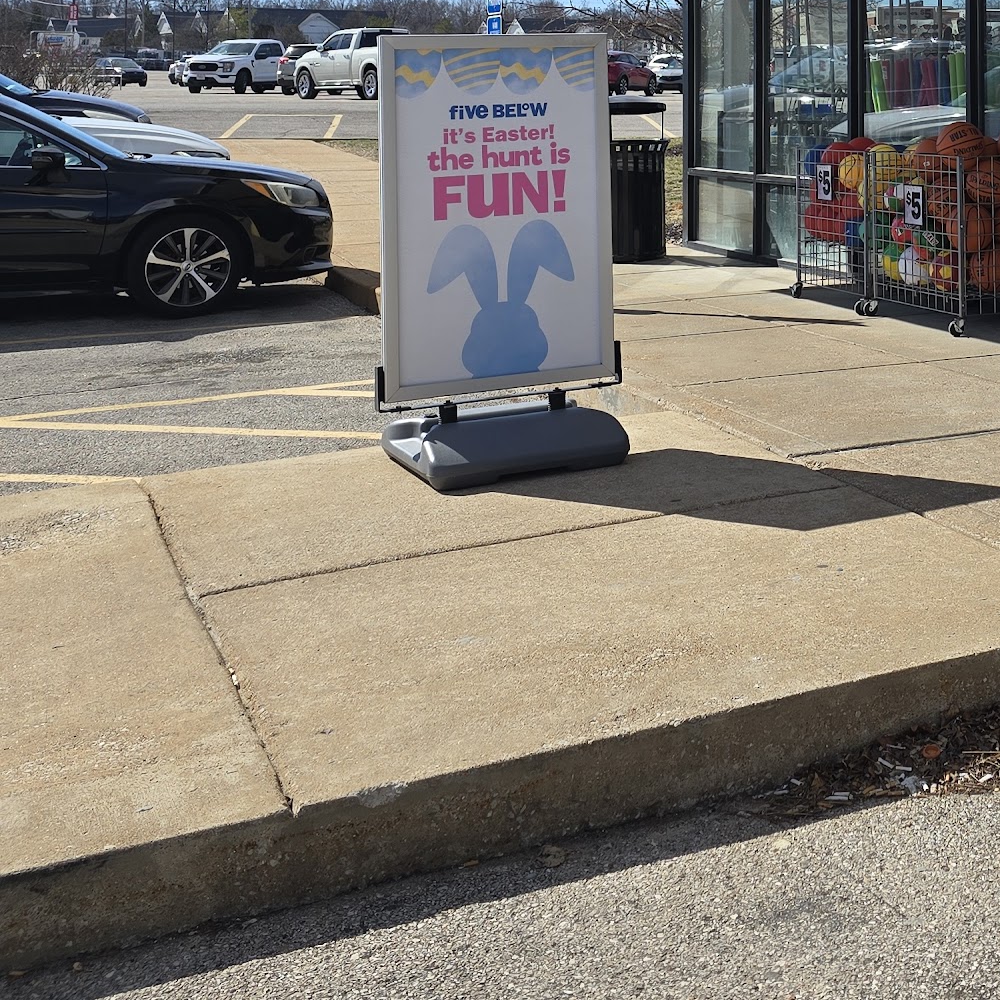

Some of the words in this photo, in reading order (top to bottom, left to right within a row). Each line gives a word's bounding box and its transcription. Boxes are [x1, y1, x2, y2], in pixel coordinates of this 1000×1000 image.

[449, 104, 488, 120] five
[492, 102, 548, 119] BELOW
[482, 124, 555, 143] Easter!
[427, 147, 474, 172] the
[481, 145, 543, 169] hunt
[550, 141, 571, 165] is
[433, 169, 567, 221] FUN!
[818, 164, 831, 196] $5
[906, 191, 921, 220] $5
